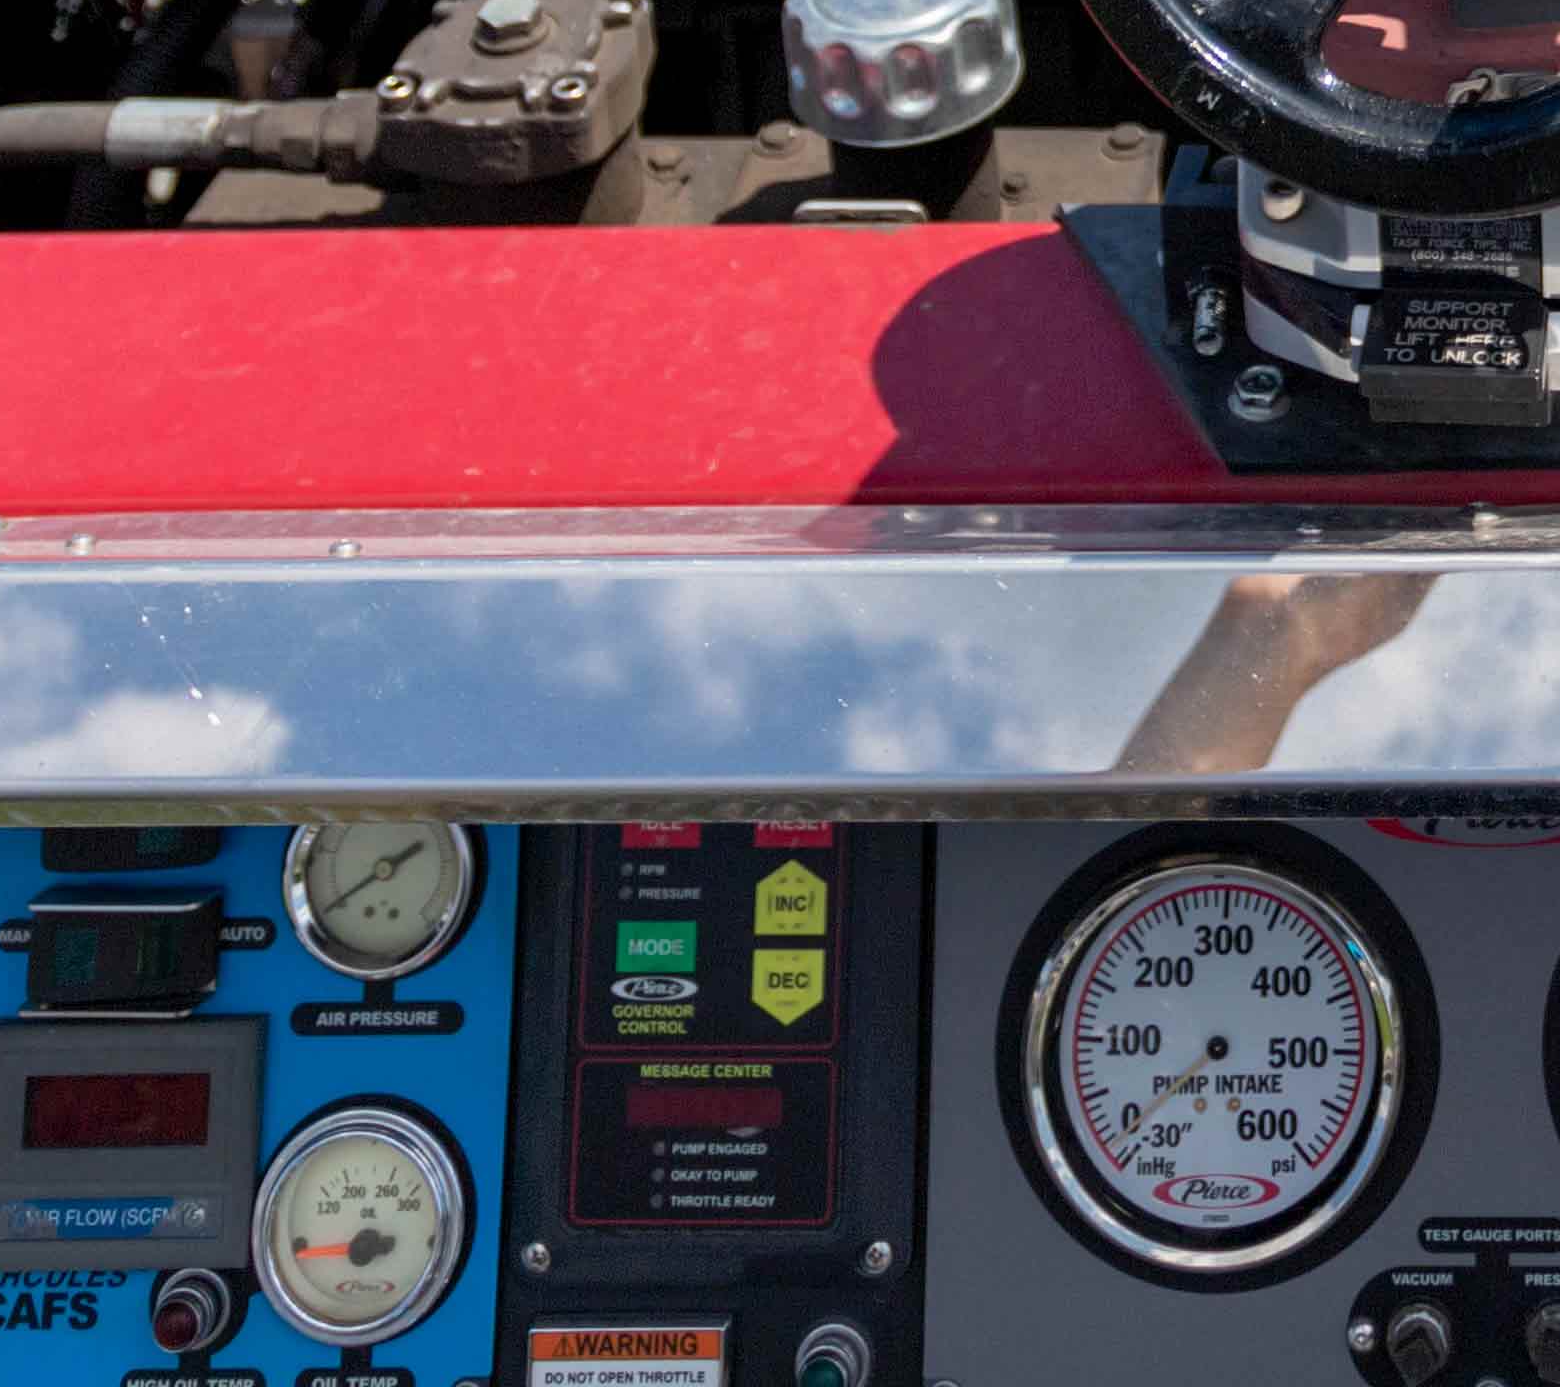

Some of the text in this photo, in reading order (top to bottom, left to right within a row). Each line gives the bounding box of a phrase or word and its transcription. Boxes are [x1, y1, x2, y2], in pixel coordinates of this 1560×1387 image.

[1407, 300, 1514, 316] SUPPORT
[1395, 332, 1440, 345] LIFT
[1384, 348, 1522, 365] TO UNLOCK
[638, 888, 701, 900] PRESSURE
[775, 896, 807, 912] INC
[219, 927, 266, 940] AUTO
[1194, 925, 1253, 955] 300
[628, 939, 685, 955] MODE
[768, 972, 808, 988] DEC
[1134, 957, 1193, 987] 200
[1251, 966, 1311, 997] 400
[316, 1011, 438, 1026] AIR PRESSURE
[612, 1004, 695, 1018] GOVERNOR
[618, 1021, 688, 1034] CONTROL
[1106, 1025, 1160, 1055] 100
[1268, 1037, 1327, 1068] 500
[640, 1065, 772, 1077] MESSAGE CENTER
[1153, 1074, 1283, 1094] PUMP INTAKE
[1122, 1103, 1140, 1134] 0
[1237, 1109, 1297, 1141] 600
[672, 1143, 767, 1155] PUMP ENGAGED
[1137, 1157, 1176, 1178] inHg
[1272, 1156, 1296, 1176] psi
[671, 1170, 758, 1181] OKAY TO PUMP
[342, 1187, 366, 1199] 200
[375, 1185, 399, 1197] 260
[1181, 1179, 1250, 1203] Pierce
[317, 1201, 340, 1214] 120
[397, 1199, 421, 1211] 300
[671, 1195, 776, 1207] THROTTLE READY
[65, 1209, 116, 1226] FLOW
[1424, 1229, 1458, 1242] TEST
[1462, 1229, 1512, 1242] GAUGE
[1392, 1274, 1454, 1286] VACUUM
[576, 1332, 699, 1356] WARNING
[545, 1371, 705, 1384] DO NOT OPEN THROTTLE
